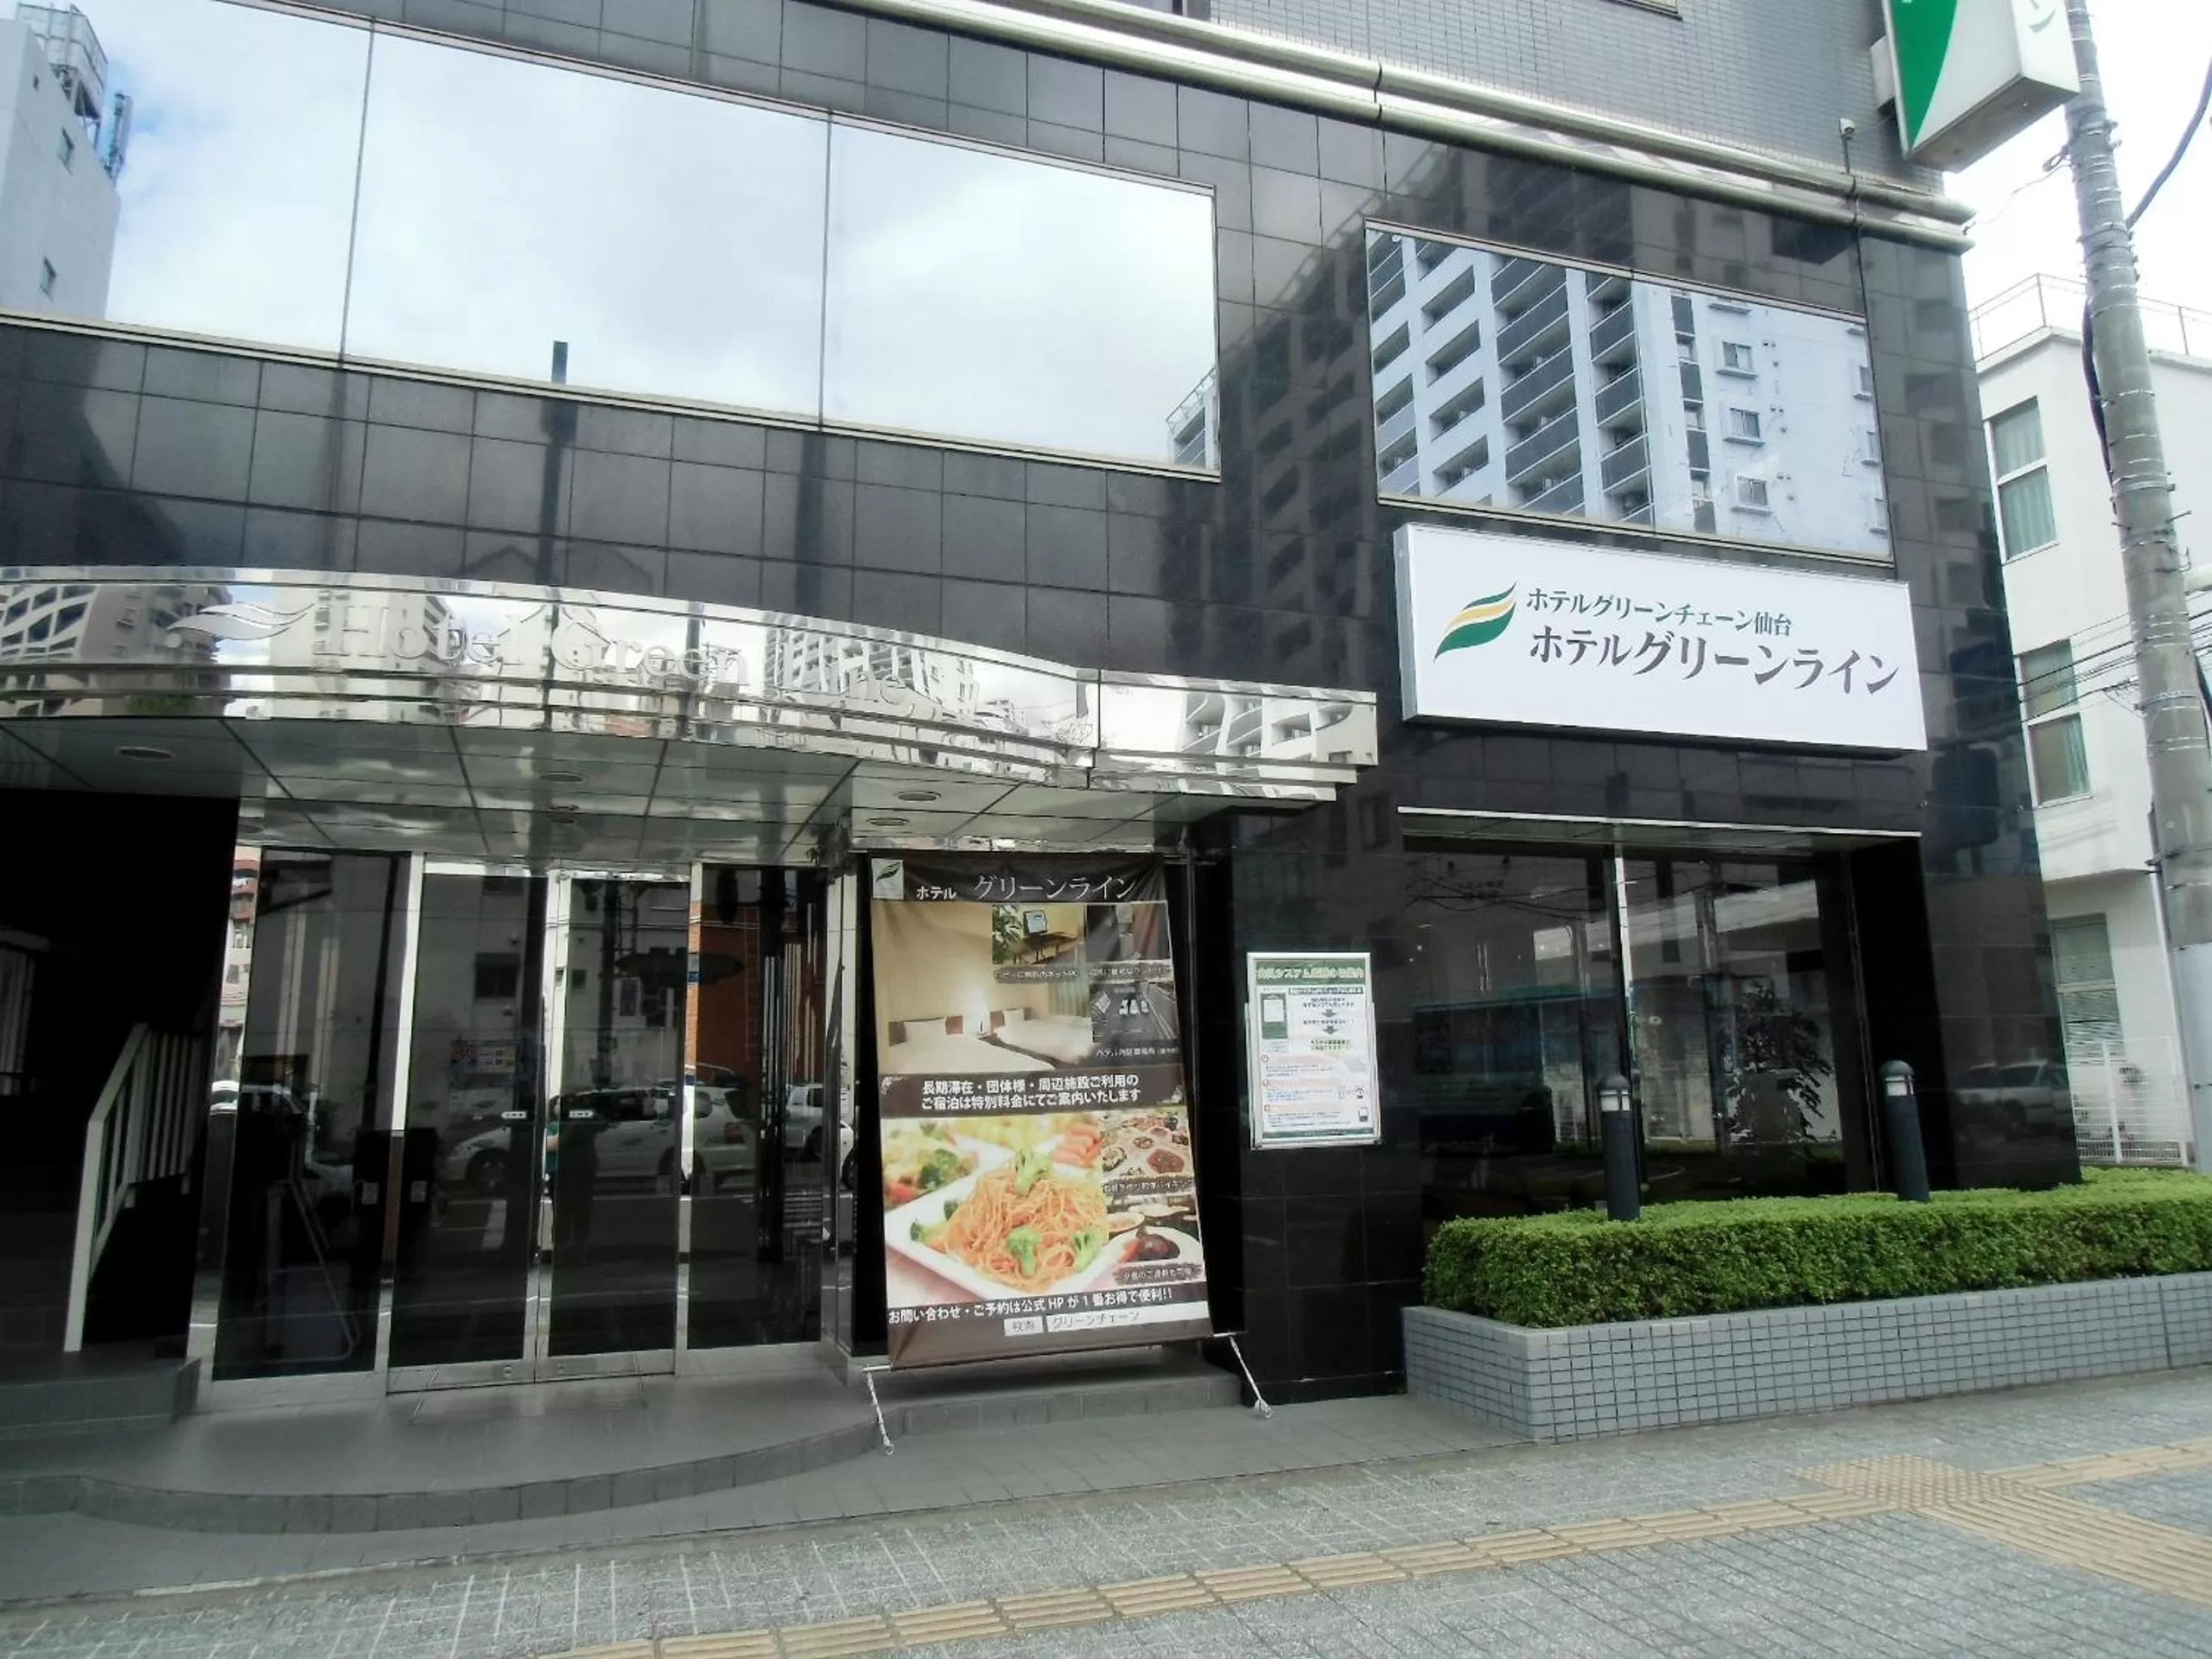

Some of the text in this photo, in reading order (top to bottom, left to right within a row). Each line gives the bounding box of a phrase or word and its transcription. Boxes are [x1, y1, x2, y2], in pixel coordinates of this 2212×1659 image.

[1526, 588, 1791, 638] ホテルグリーンチェーン仙台
[313, 602, 525, 666] Hotel
[550, 620, 750, 687] Green
[1529, 626, 1899, 695] ホテルグリーンライン
[916, 874, 1136, 900] ホテル グリーンライン
